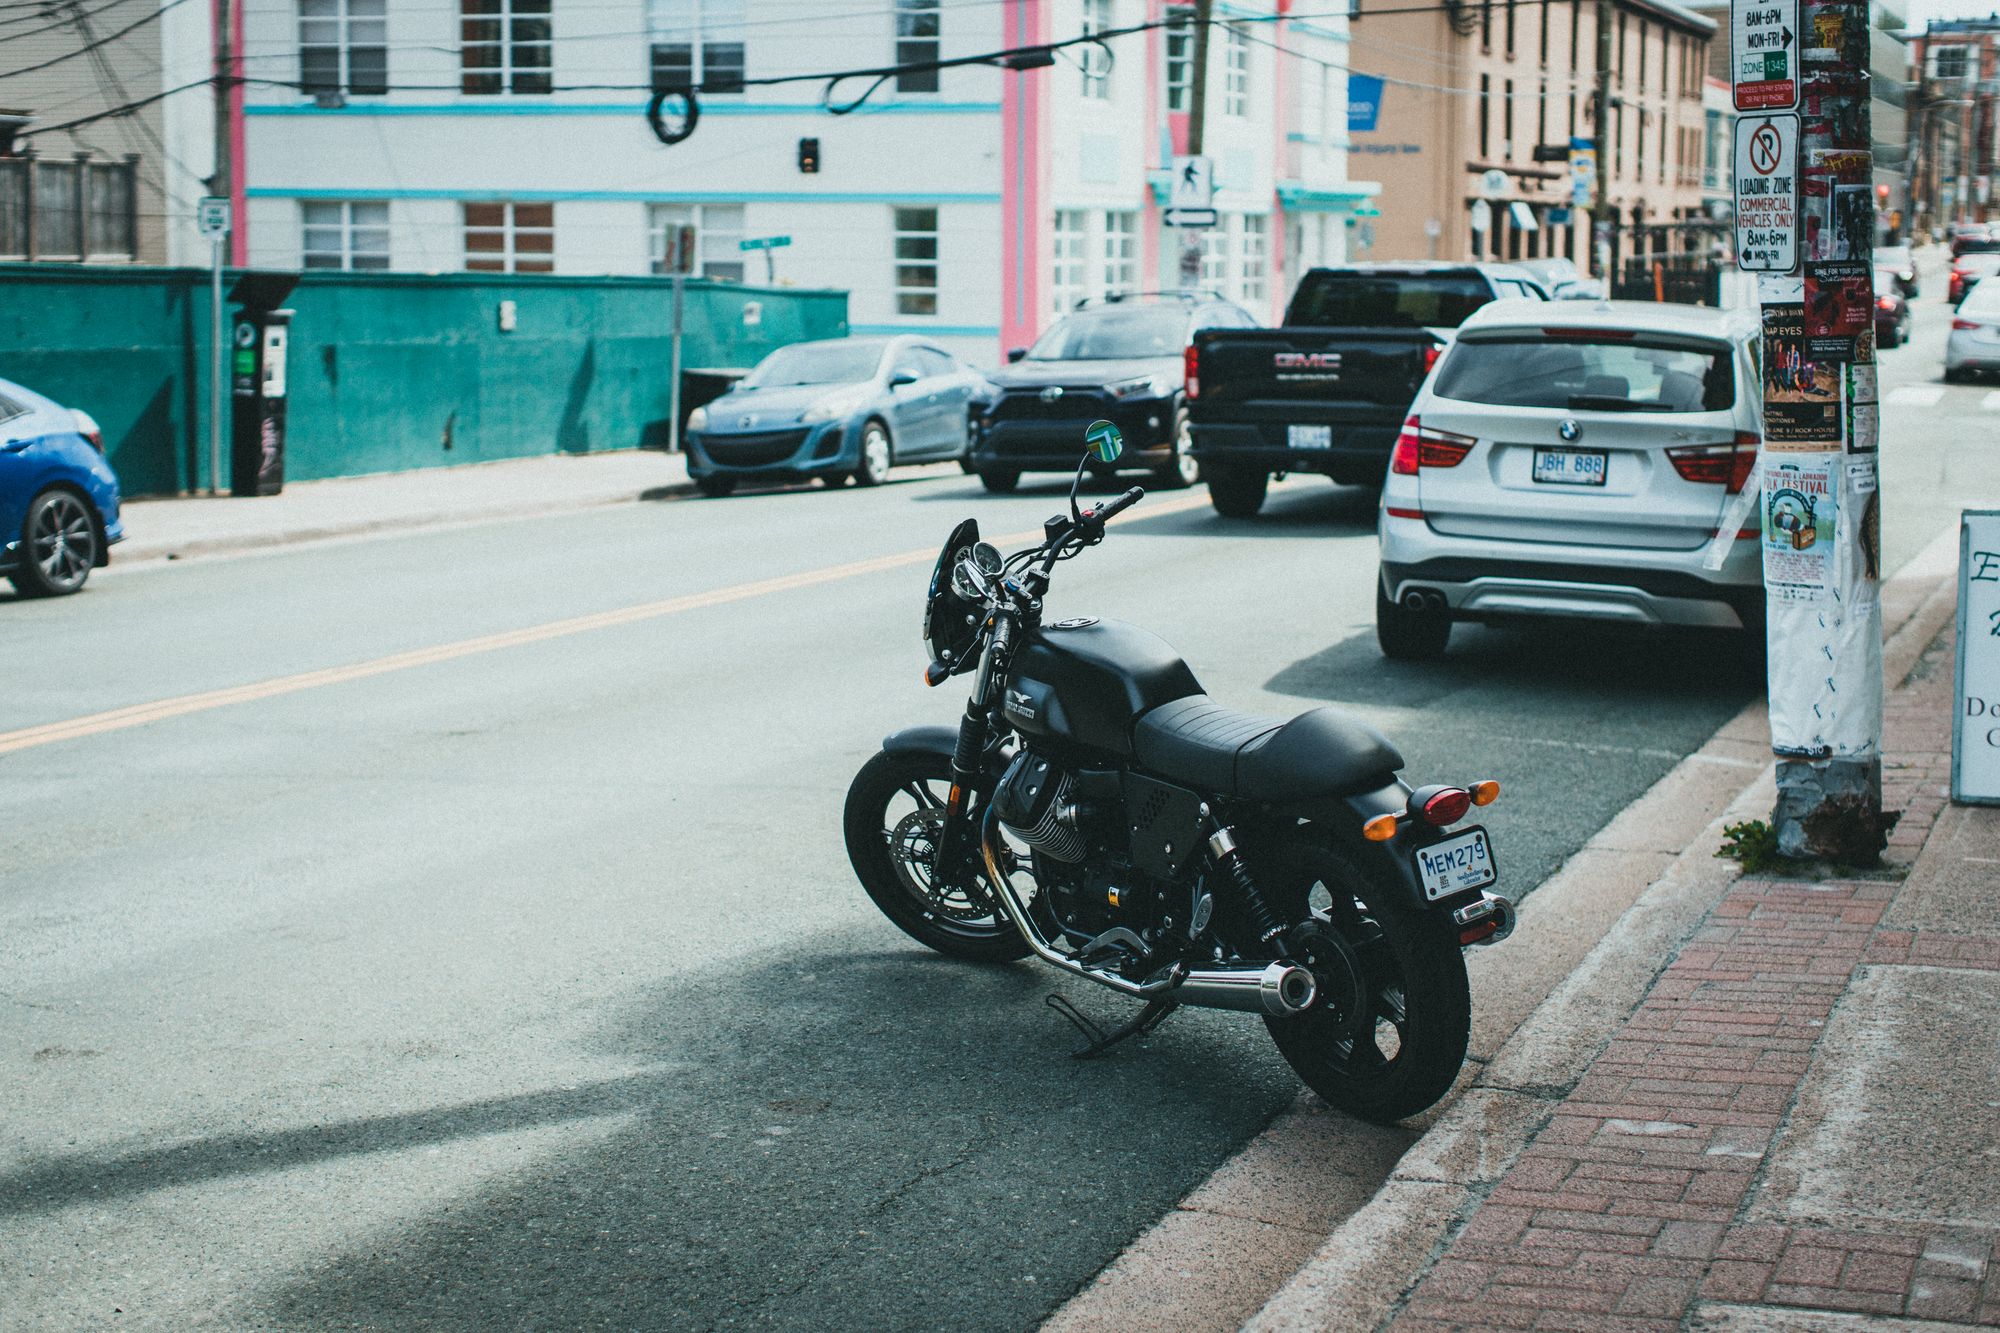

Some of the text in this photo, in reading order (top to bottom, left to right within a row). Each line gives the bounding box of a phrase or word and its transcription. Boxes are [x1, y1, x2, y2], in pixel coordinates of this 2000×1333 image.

[1746, 9, 1782, 27] 8AM-6PM
[1747, 31, 1780, 48] MON-FRI
[1743, 59, 1787, 74] ZONE 1345
[1739, 177, 1792, 196] LOADING ZONE
[1739, 197, 1792, 212] COMMERCIAL
[1738, 213, 1794, 228] VEHICLES ONLY
[1747, 229, 1787, 246] 8AM-6PM
[1754, 250, 1780, 260] MON-FRI
[1779, 326, 1803, 336] EYES
[1275, 353, 1342, 368] GMC
[1537, 453, 1603, 474] JBH 888
[1781, 479, 1830, 495] FESTIVAL
[1423, 842, 1485, 877] MEM279
